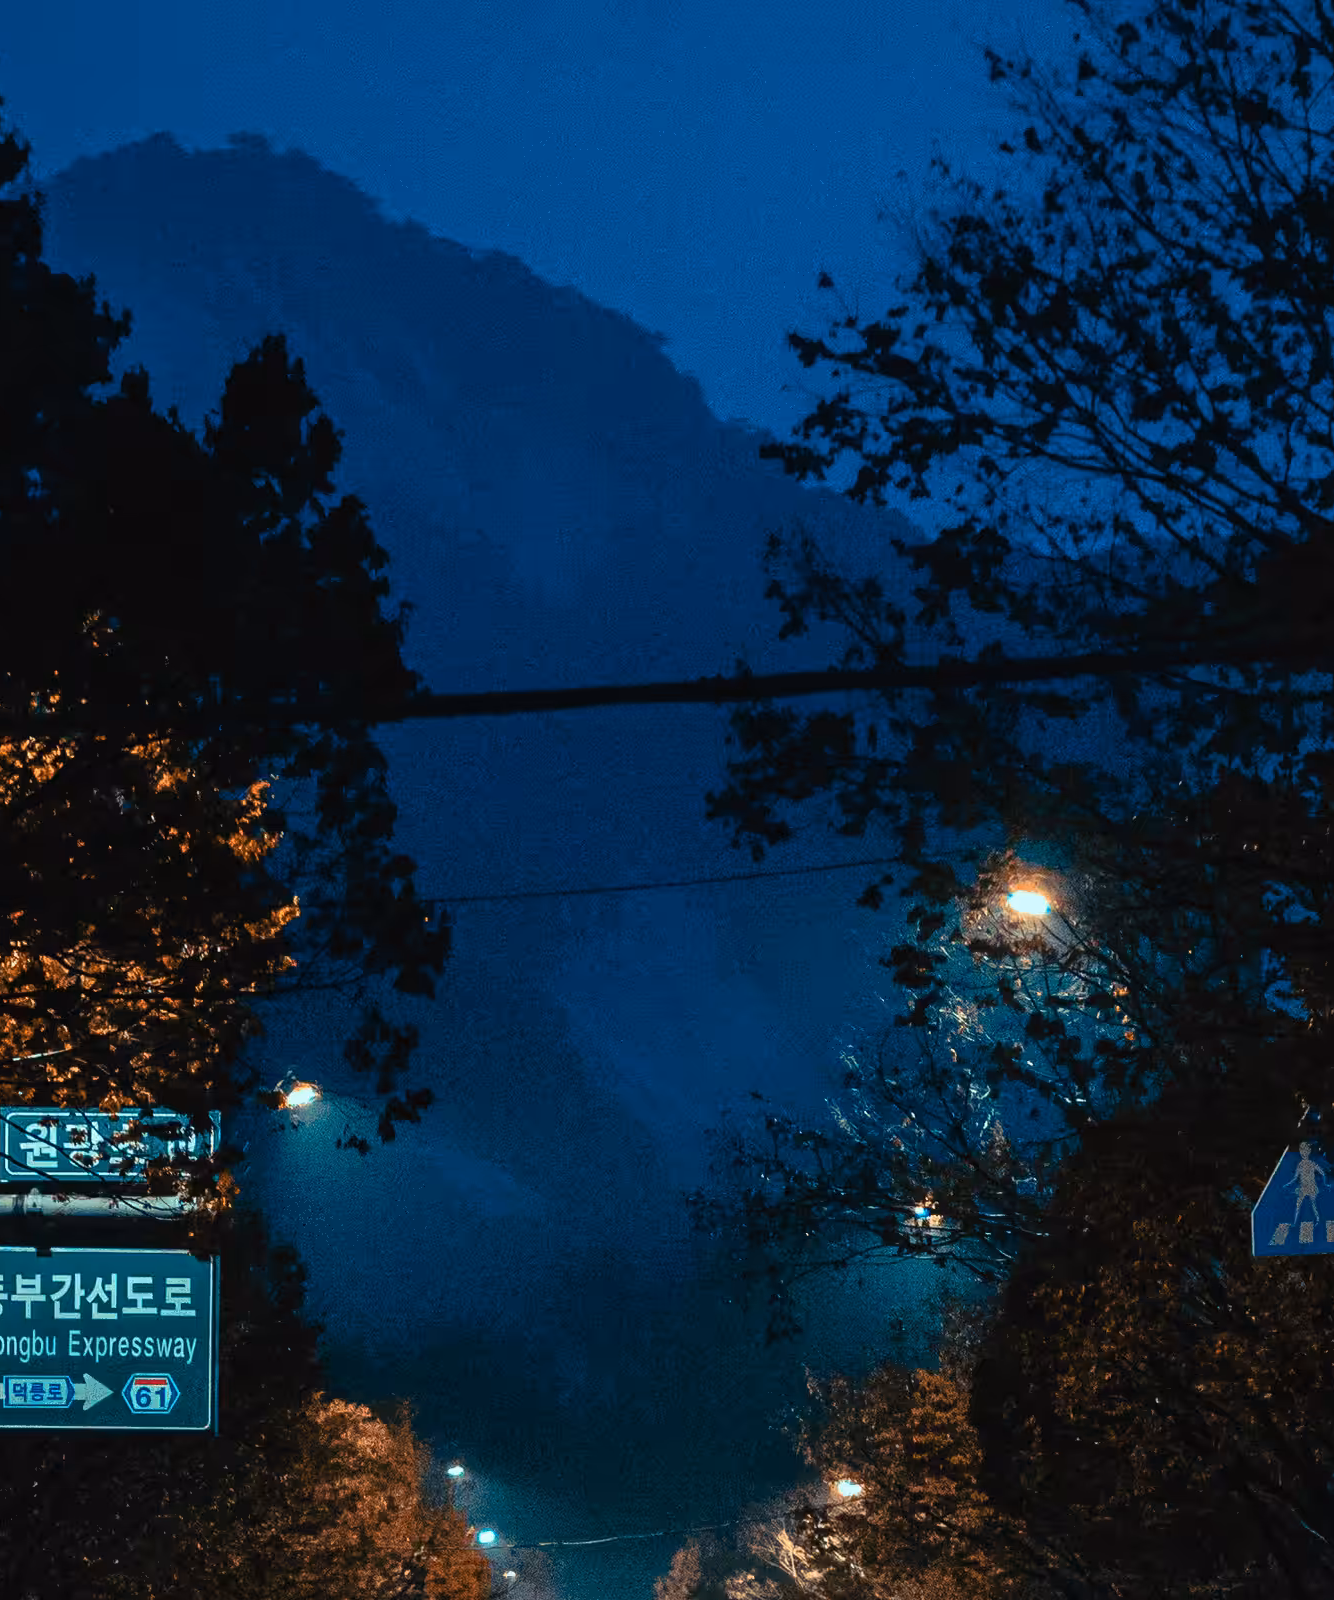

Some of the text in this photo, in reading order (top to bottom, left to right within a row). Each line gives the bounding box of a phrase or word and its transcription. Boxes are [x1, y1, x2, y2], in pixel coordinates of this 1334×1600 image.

[68, 1329, 197, 1365] Expressway
[12, 1381, 65, 1402] 덕릉로
[135, 1386, 169, 1409] 61
